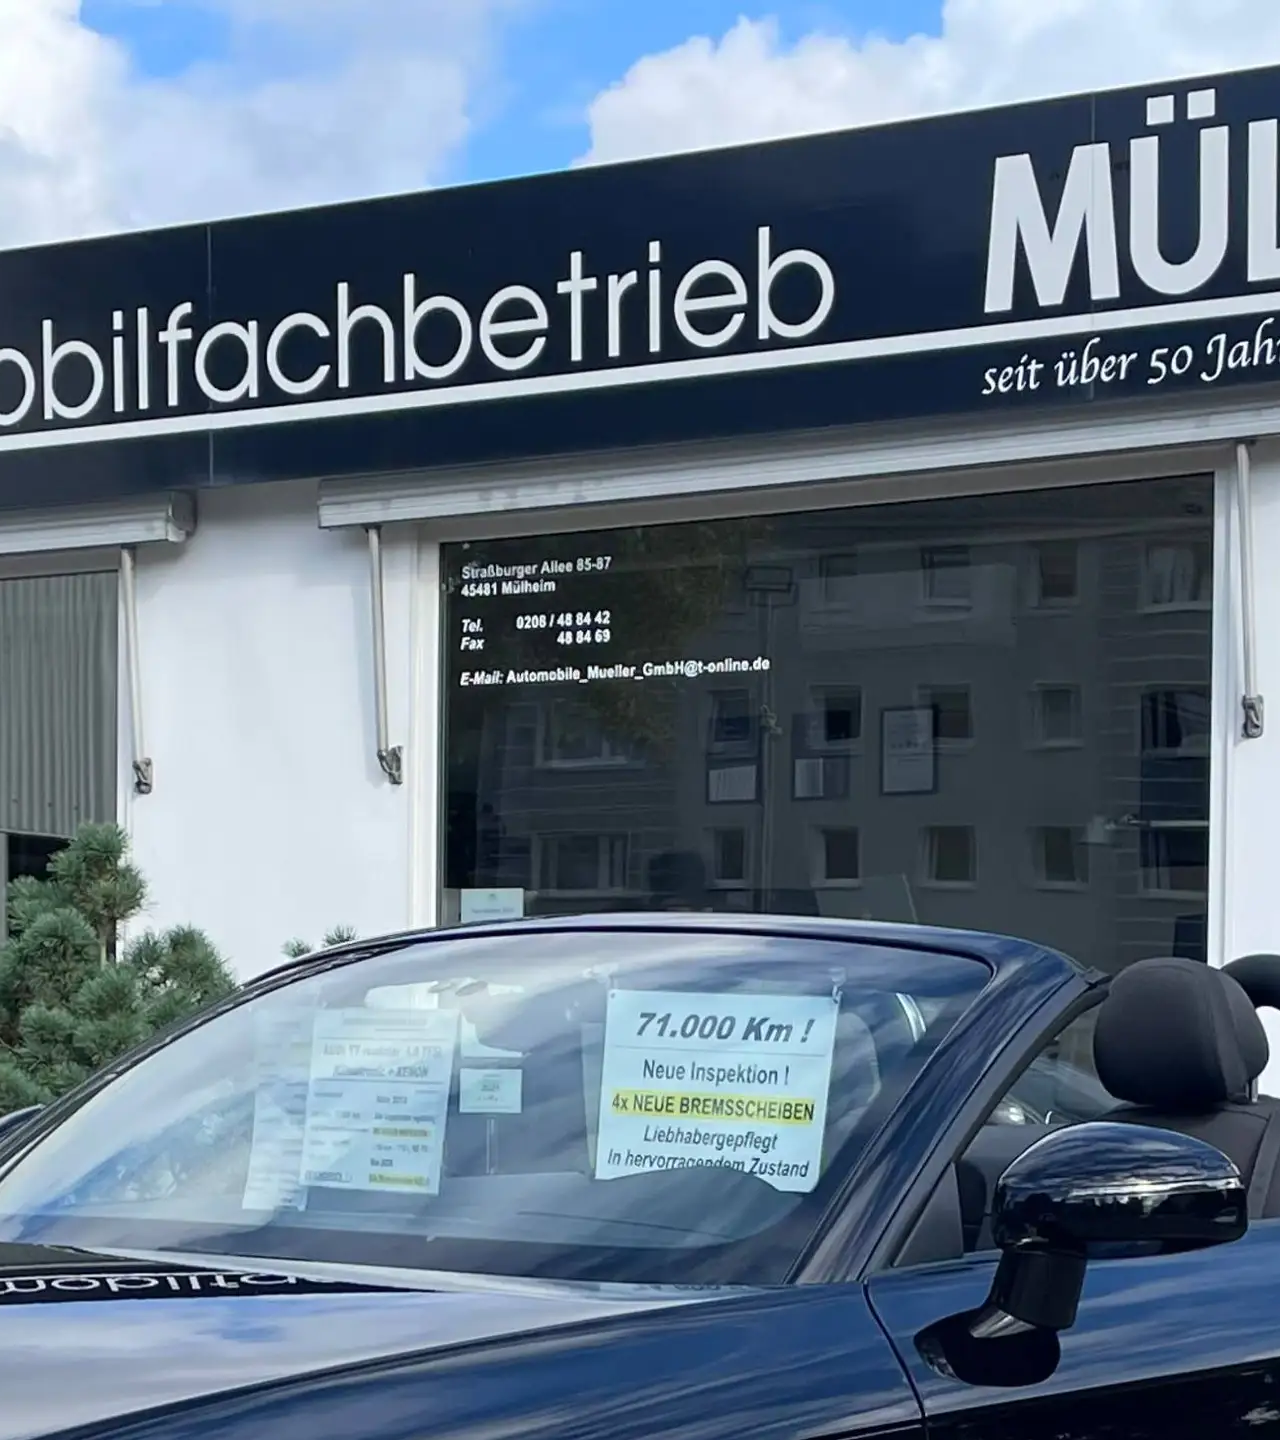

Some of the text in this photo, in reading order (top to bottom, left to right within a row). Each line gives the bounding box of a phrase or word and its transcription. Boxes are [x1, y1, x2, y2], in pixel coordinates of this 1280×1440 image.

[981, 353, 1045, 395] seit
[1053, 336, 1139, 387] über
[1146, 345, 1194, 385] 50
[461, 556, 613, 580] Straßburger Allee 85-87
[461, 578, 556, 597] 45481 Mülheim
[461, 618, 484, 633] Tel.
[516, 614, 547, 629] 0208
[556, 612, 573, 627] 48
[575, 611, 592, 626] 84
[594, 610, 611, 625] 42
[460, 628, 611, 650] Fax 48 84 69
[459, 656, 770, 686] E-Mail: Automobile_Mueller_GmbH@t-online.de
[635, 1011, 816, 1043] 71.000 Km !
[642, 1059, 790, 1087] Neue Inspektion !
[612, 1093, 815, 1121] 4x NEUE BREMSSCHEIBEN
[643, 1124, 779, 1154] Liebhabergepflegt
[608, 1149, 622, 1165] In
[749, 1156, 811, 1178] Zustand
